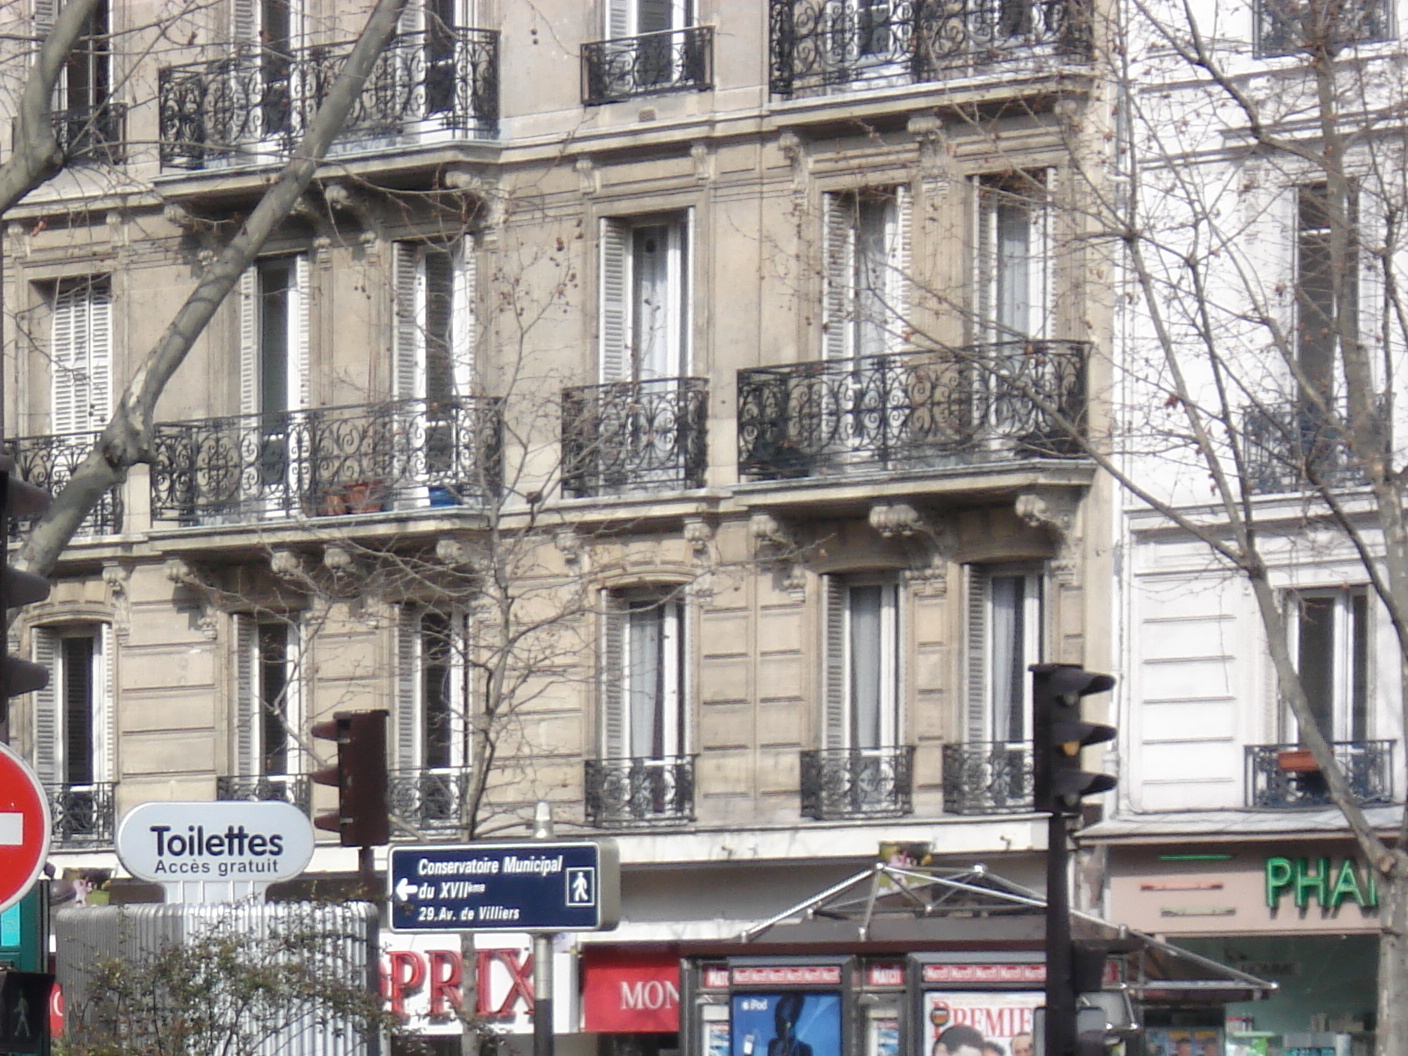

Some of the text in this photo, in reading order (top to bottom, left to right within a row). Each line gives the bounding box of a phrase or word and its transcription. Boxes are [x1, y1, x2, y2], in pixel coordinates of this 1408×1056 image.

[149, 825, 284, 857] Toilettes
[154, 858, 279, 876] Accès gratuit
[418, 855, 564, 877] Conservatoire Municipal
[418, 882, 434, 899] du
[461, 906, 474, 920] de
[478, 906, 520, 921] Villiers
